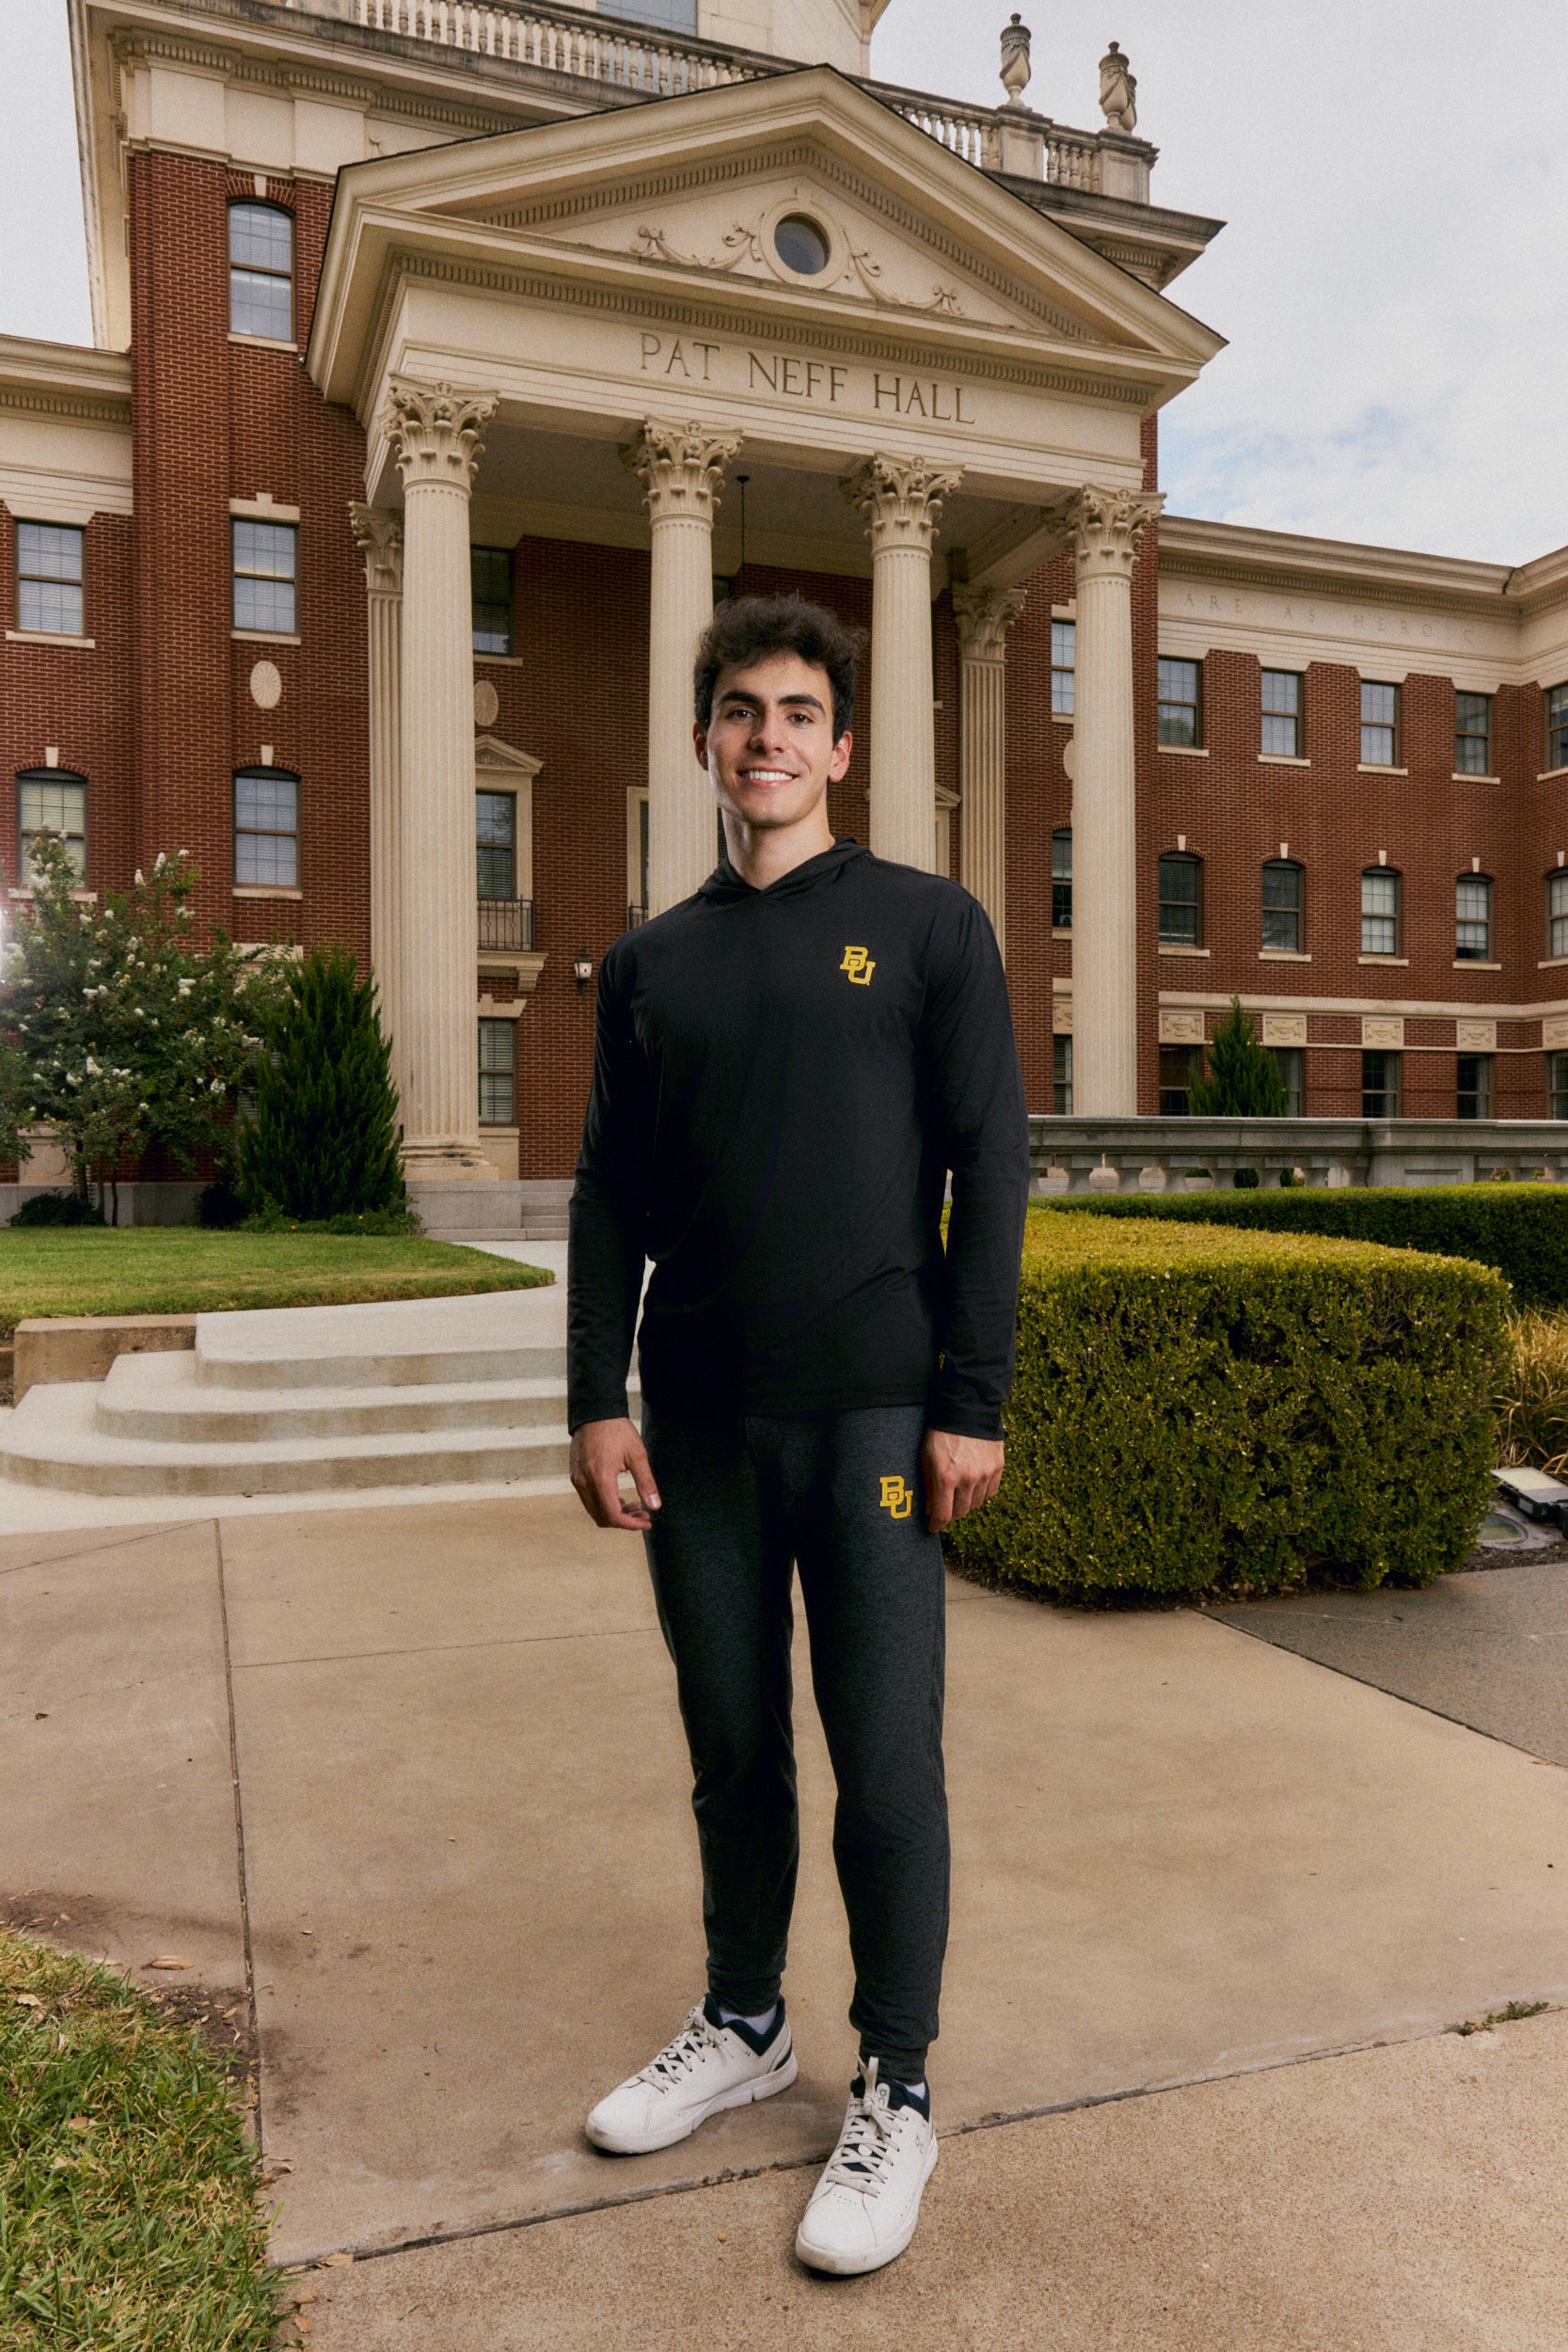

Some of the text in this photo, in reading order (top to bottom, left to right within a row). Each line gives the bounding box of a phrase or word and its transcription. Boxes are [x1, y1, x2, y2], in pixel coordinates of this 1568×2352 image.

[640, 332, 975, 425] PAT NEFF HALL
[1183, 592, 1243, 614] ARE
[1282, 605, 1317, 624] AS
[839, 946, 876, 986] BU
[879, 1475, 913, 1519] BU
